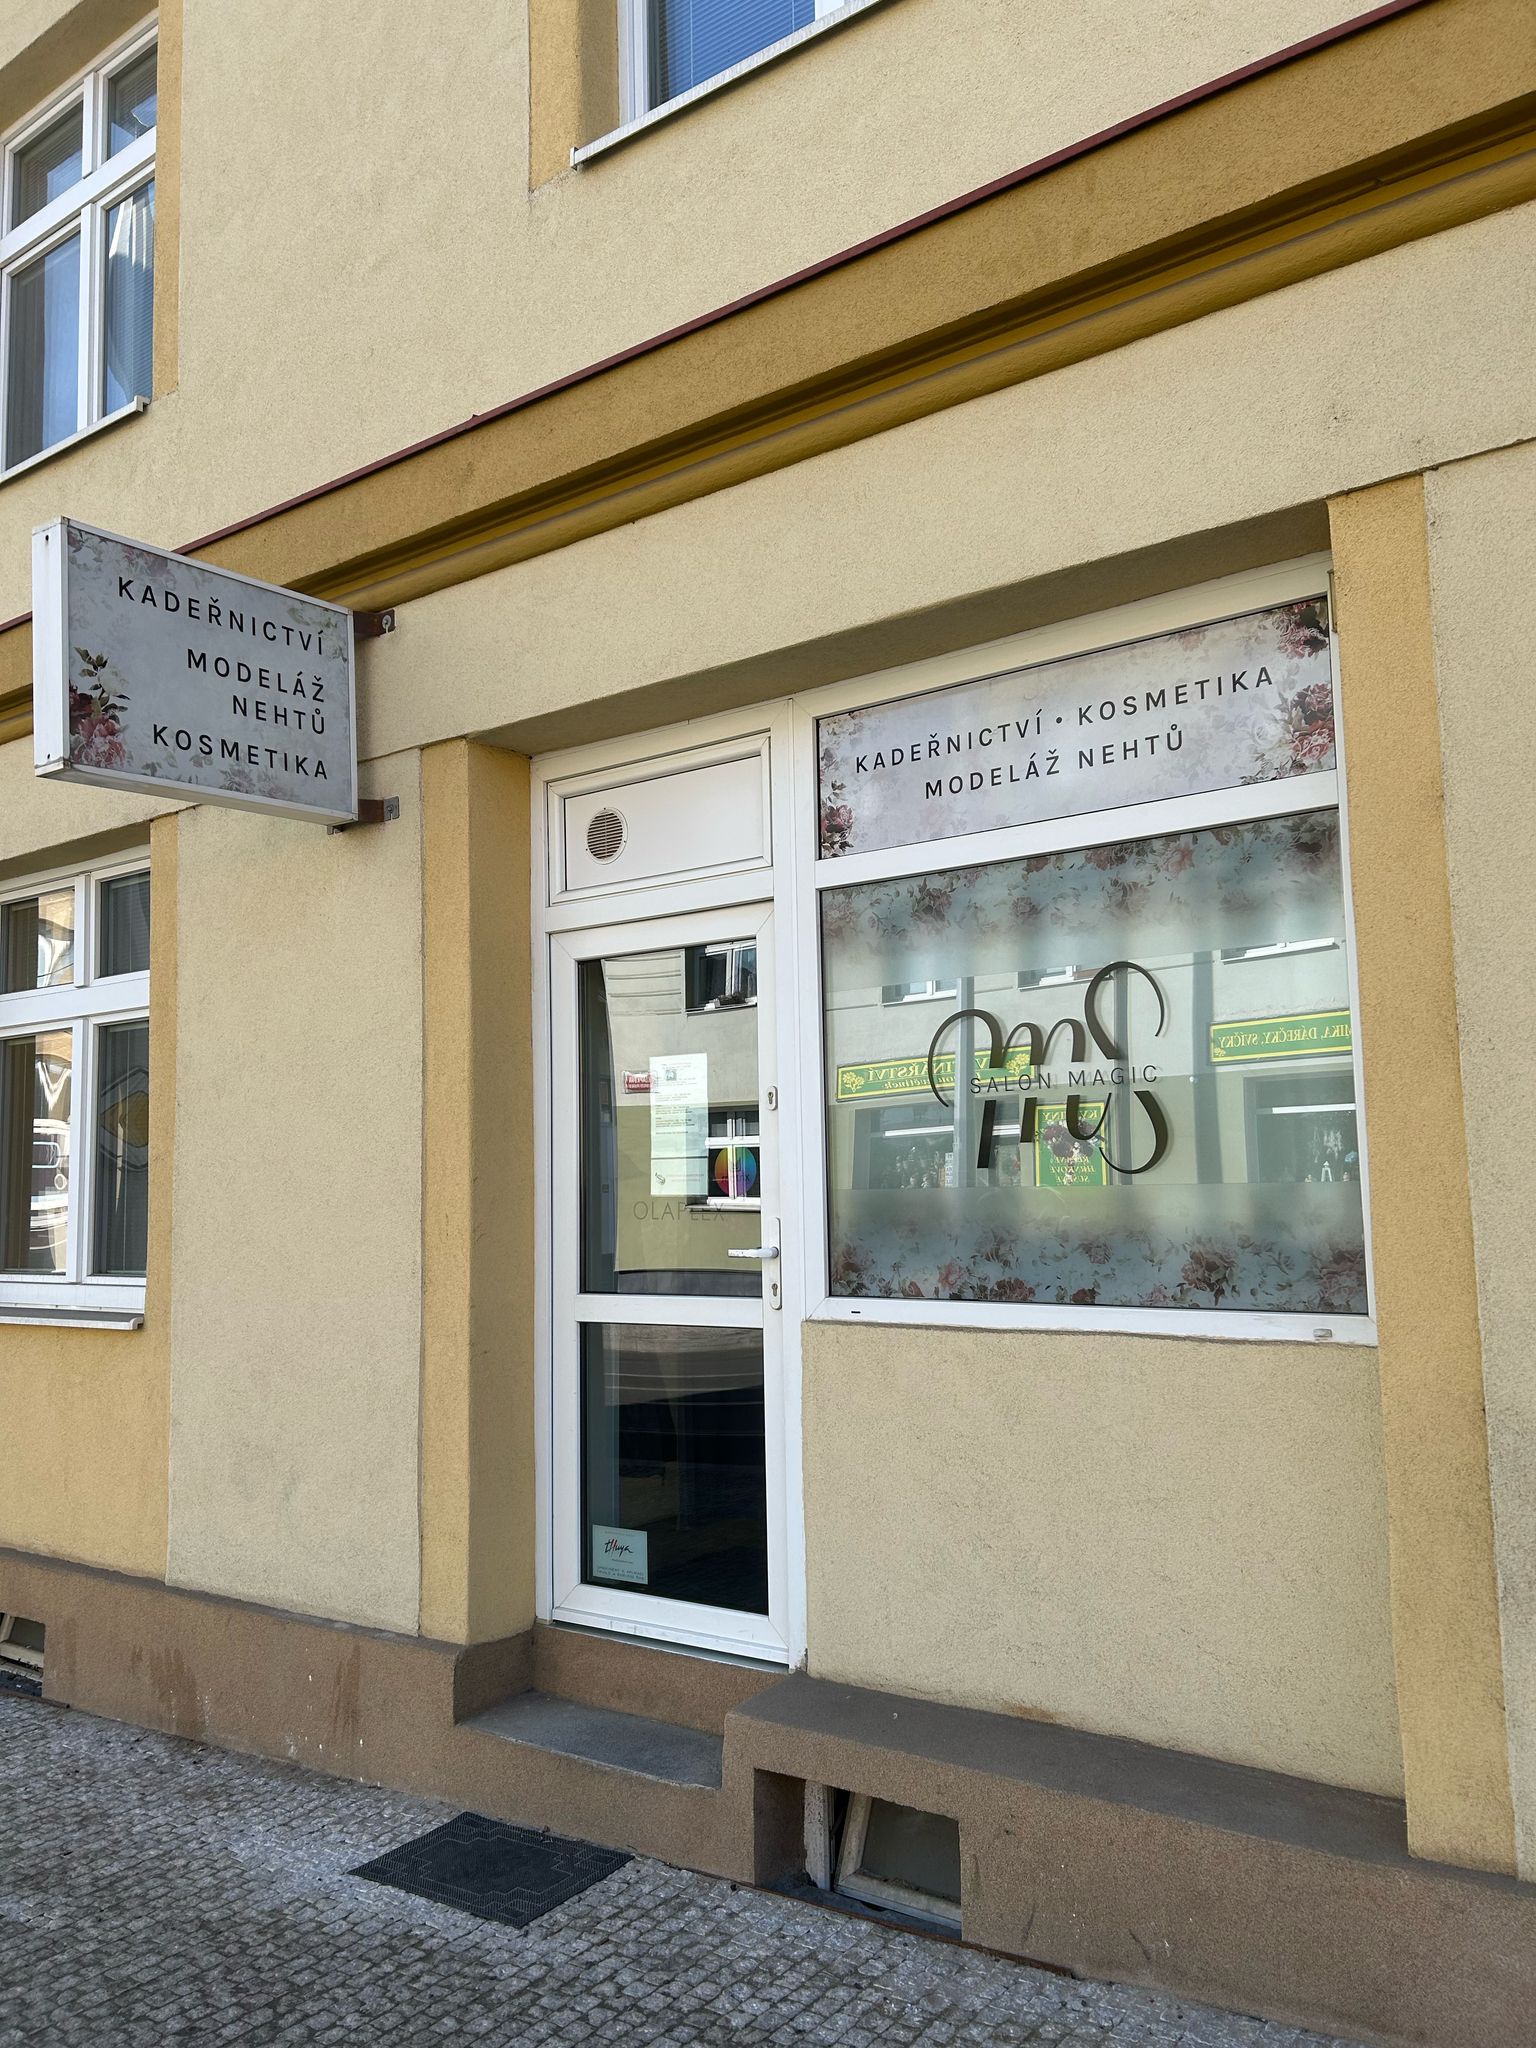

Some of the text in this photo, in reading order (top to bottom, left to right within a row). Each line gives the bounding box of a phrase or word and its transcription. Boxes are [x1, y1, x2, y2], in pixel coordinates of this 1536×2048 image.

[117, 576, 324, 656] KADEŘNICTVÍ
[187, 648, 325, 703] MODELÁŽ
[232, 694, 325, 735] NEHTŮ
[855, 708, 1043, 774] KADEŘNICTVÍ
[1078, 666, 1274, 726] KOSMETIKA
[153, 724, 328, 780] KOSMETIKA
[925, 723, 1185, 800] MODELÁŽ NEHTŮ
[970, 1073, 1051, 1094] SALON
[1069, 1065, 1158, 1087] MAGIC
